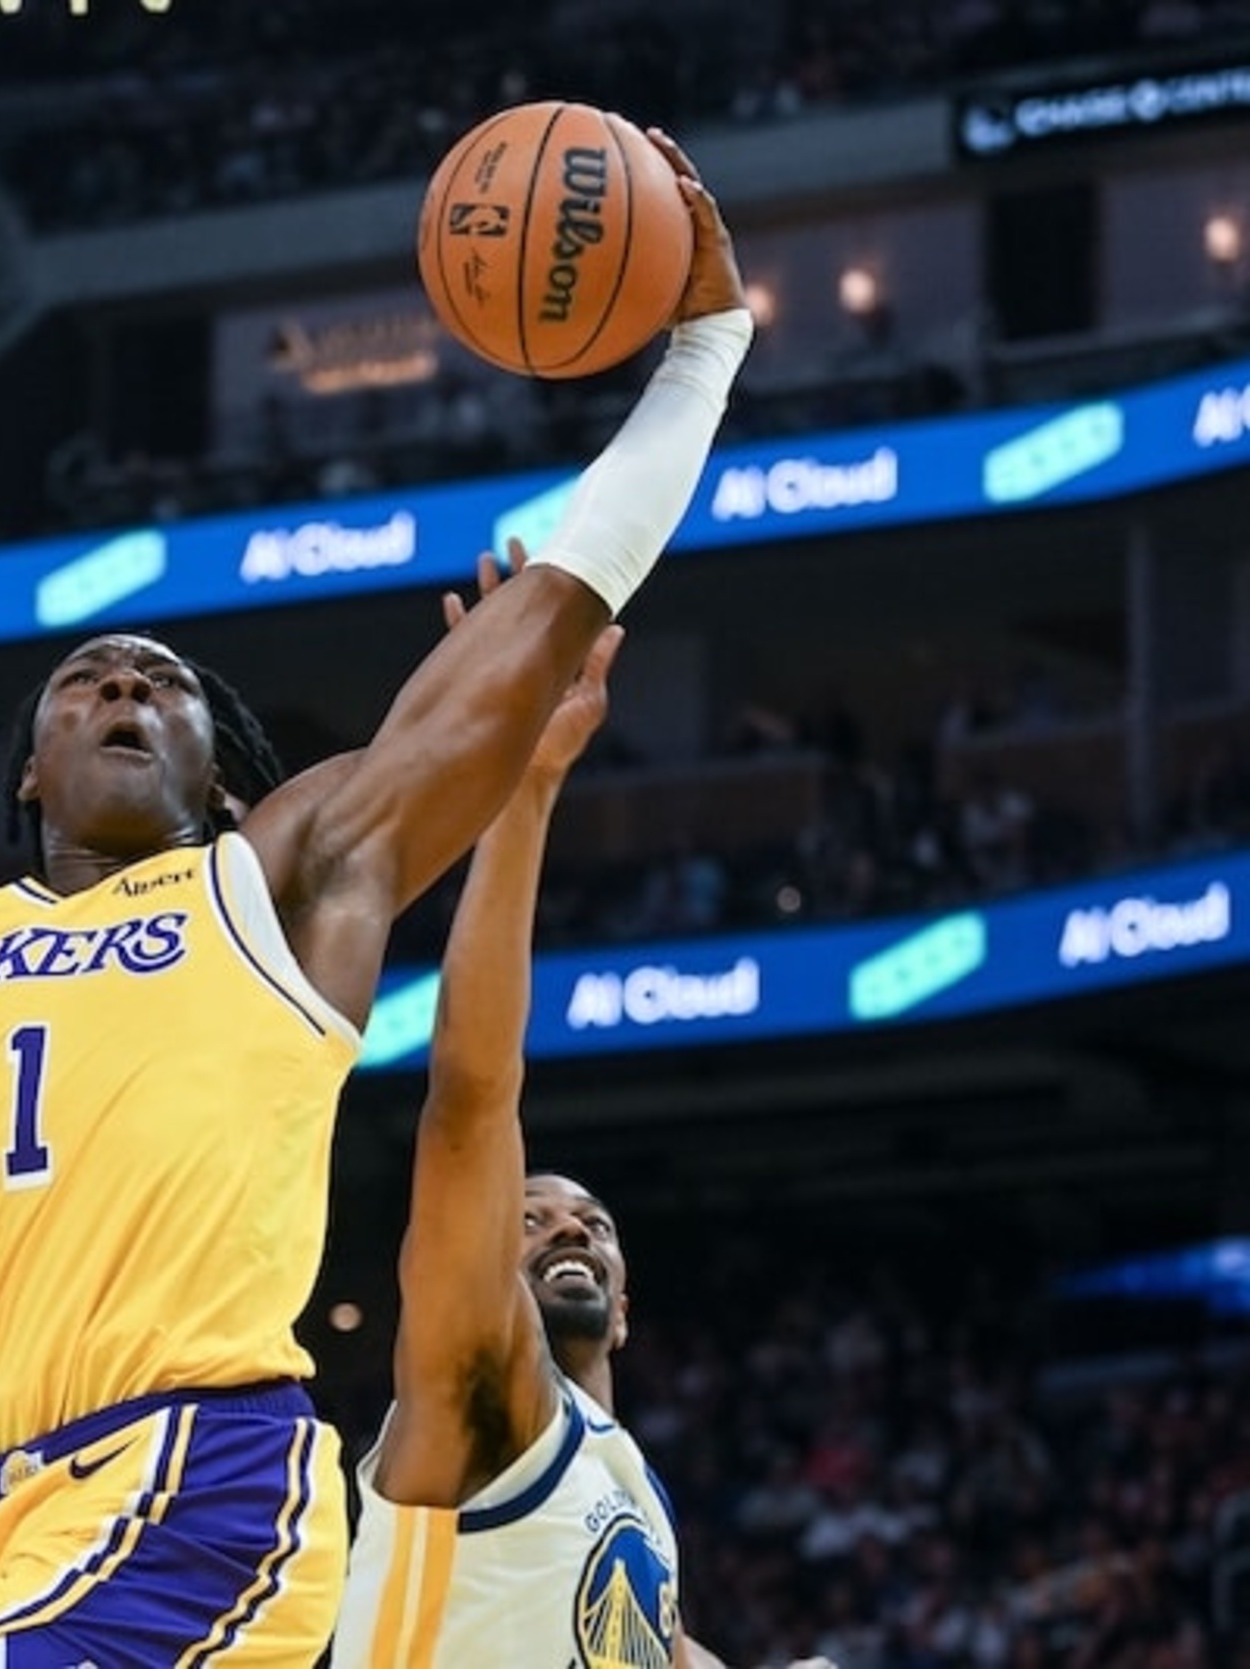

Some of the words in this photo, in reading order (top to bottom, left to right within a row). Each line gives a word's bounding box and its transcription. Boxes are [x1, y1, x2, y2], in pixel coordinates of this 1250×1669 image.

[537, 147, 608, 324] Wilson
[767, 445, 898, 515] Cloud
[292, 509, 417, 577] Cloud
[1111, 880, 1230, 958] Cloud
[623, 956, 760, 1025] Cloud
[4, 1022, 53, 1191] 1
